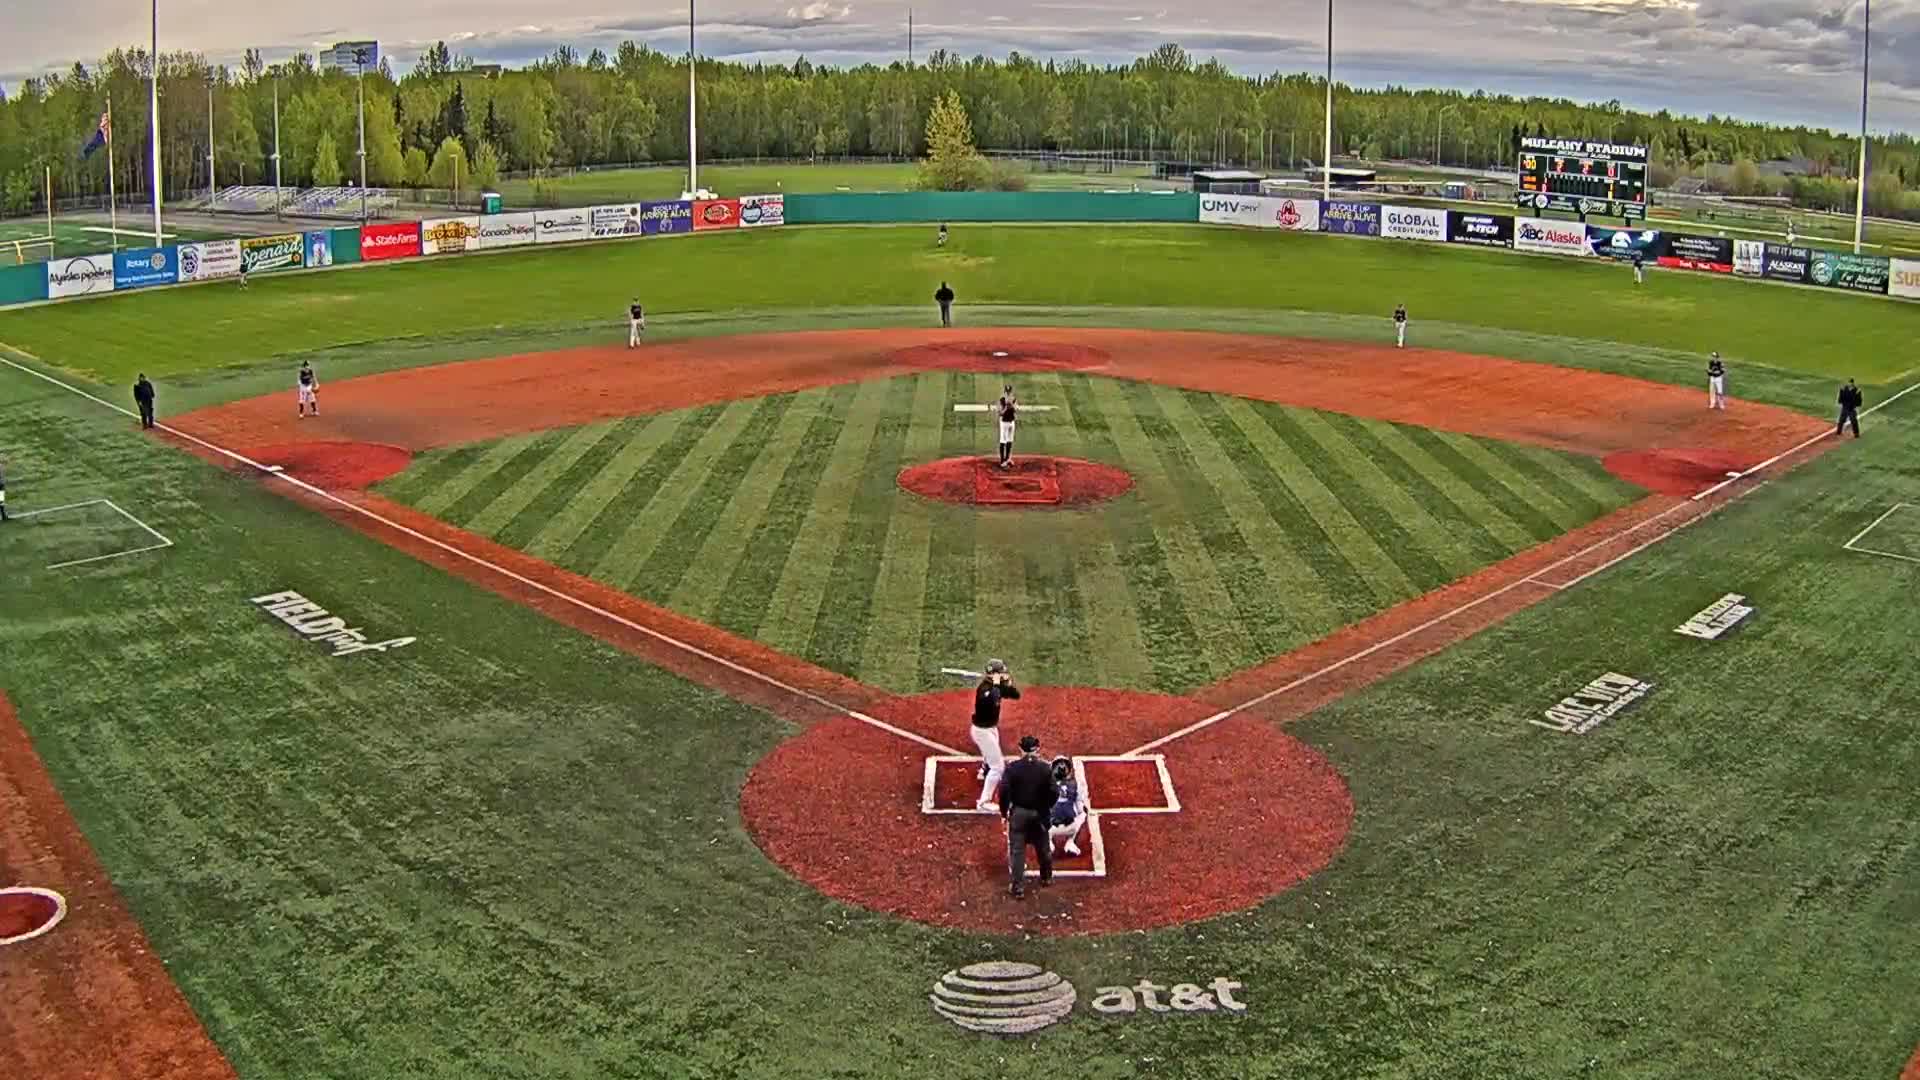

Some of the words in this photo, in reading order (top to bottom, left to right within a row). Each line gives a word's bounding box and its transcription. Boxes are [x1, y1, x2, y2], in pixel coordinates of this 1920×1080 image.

[1521, 138, 1582, 151] MULCAHY
[1586, 143, 1645, 157] STADIUM
[1323, 210, 1352, 220] ARRIVE
[1329, 203, 1358, 211] BUCKLE
[1359, 204, 1370, 212] UP
[1388, 213, 1439, 228] GLOBAL
[1388, 225, 1413, 233] CREDIT
[1415, 228, 1439, 236] UNION
[1520, 228, 1544, 241] ABC
[1545, 229, 1582, 245] Alaska
[81, 266, 113, 282] pipeline
[1573, 671, 1640, 702] VIEW
[1092, 976, 1248, 1014] at&t
